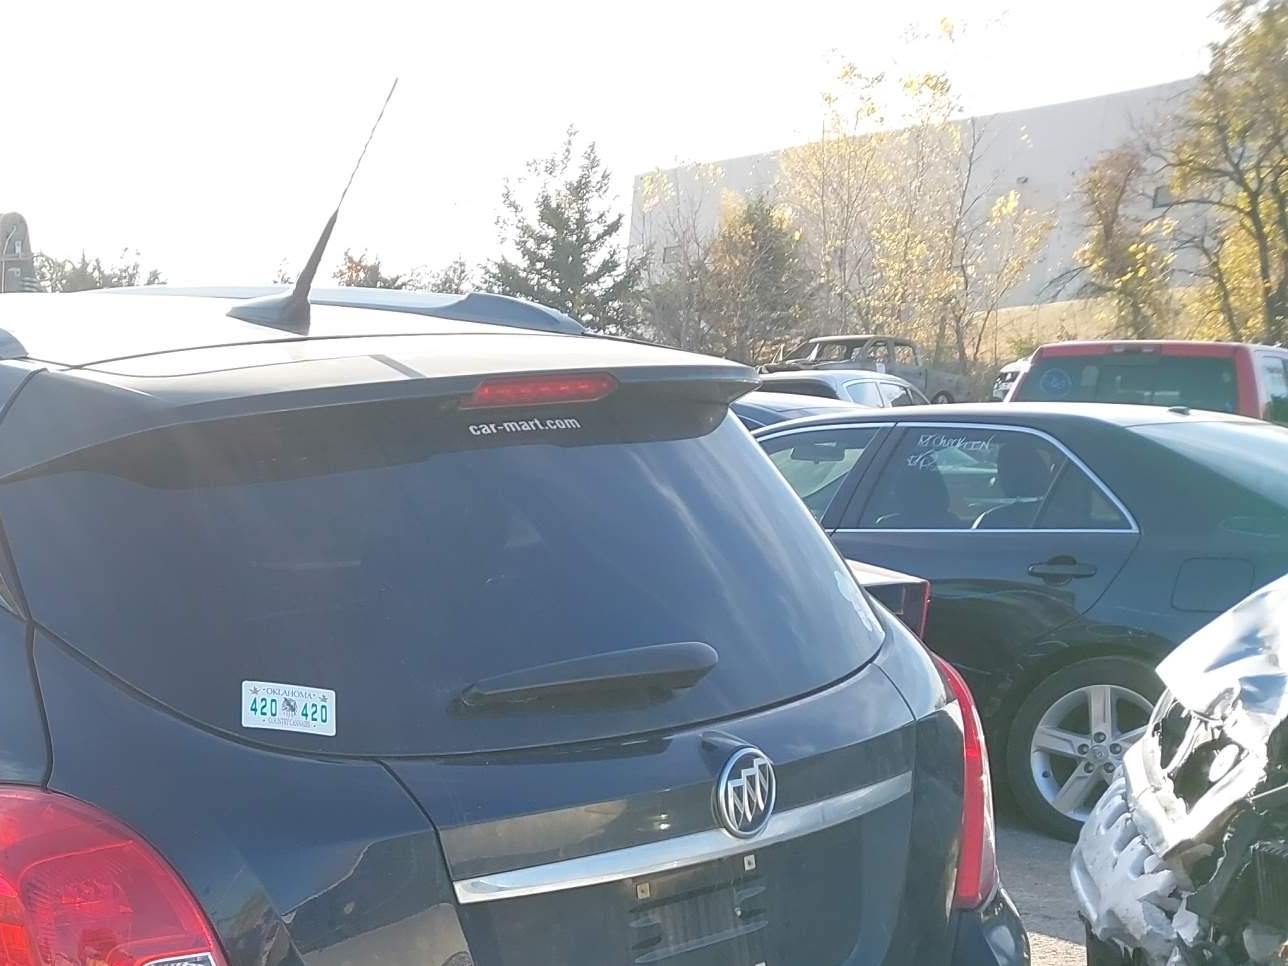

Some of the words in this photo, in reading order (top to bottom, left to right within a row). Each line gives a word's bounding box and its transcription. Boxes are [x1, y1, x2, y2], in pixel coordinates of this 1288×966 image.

[468, 418, 582, 436] car-mart.com
[250, 697, 278, 717] 420
[300, 702, 328, 724] 420
